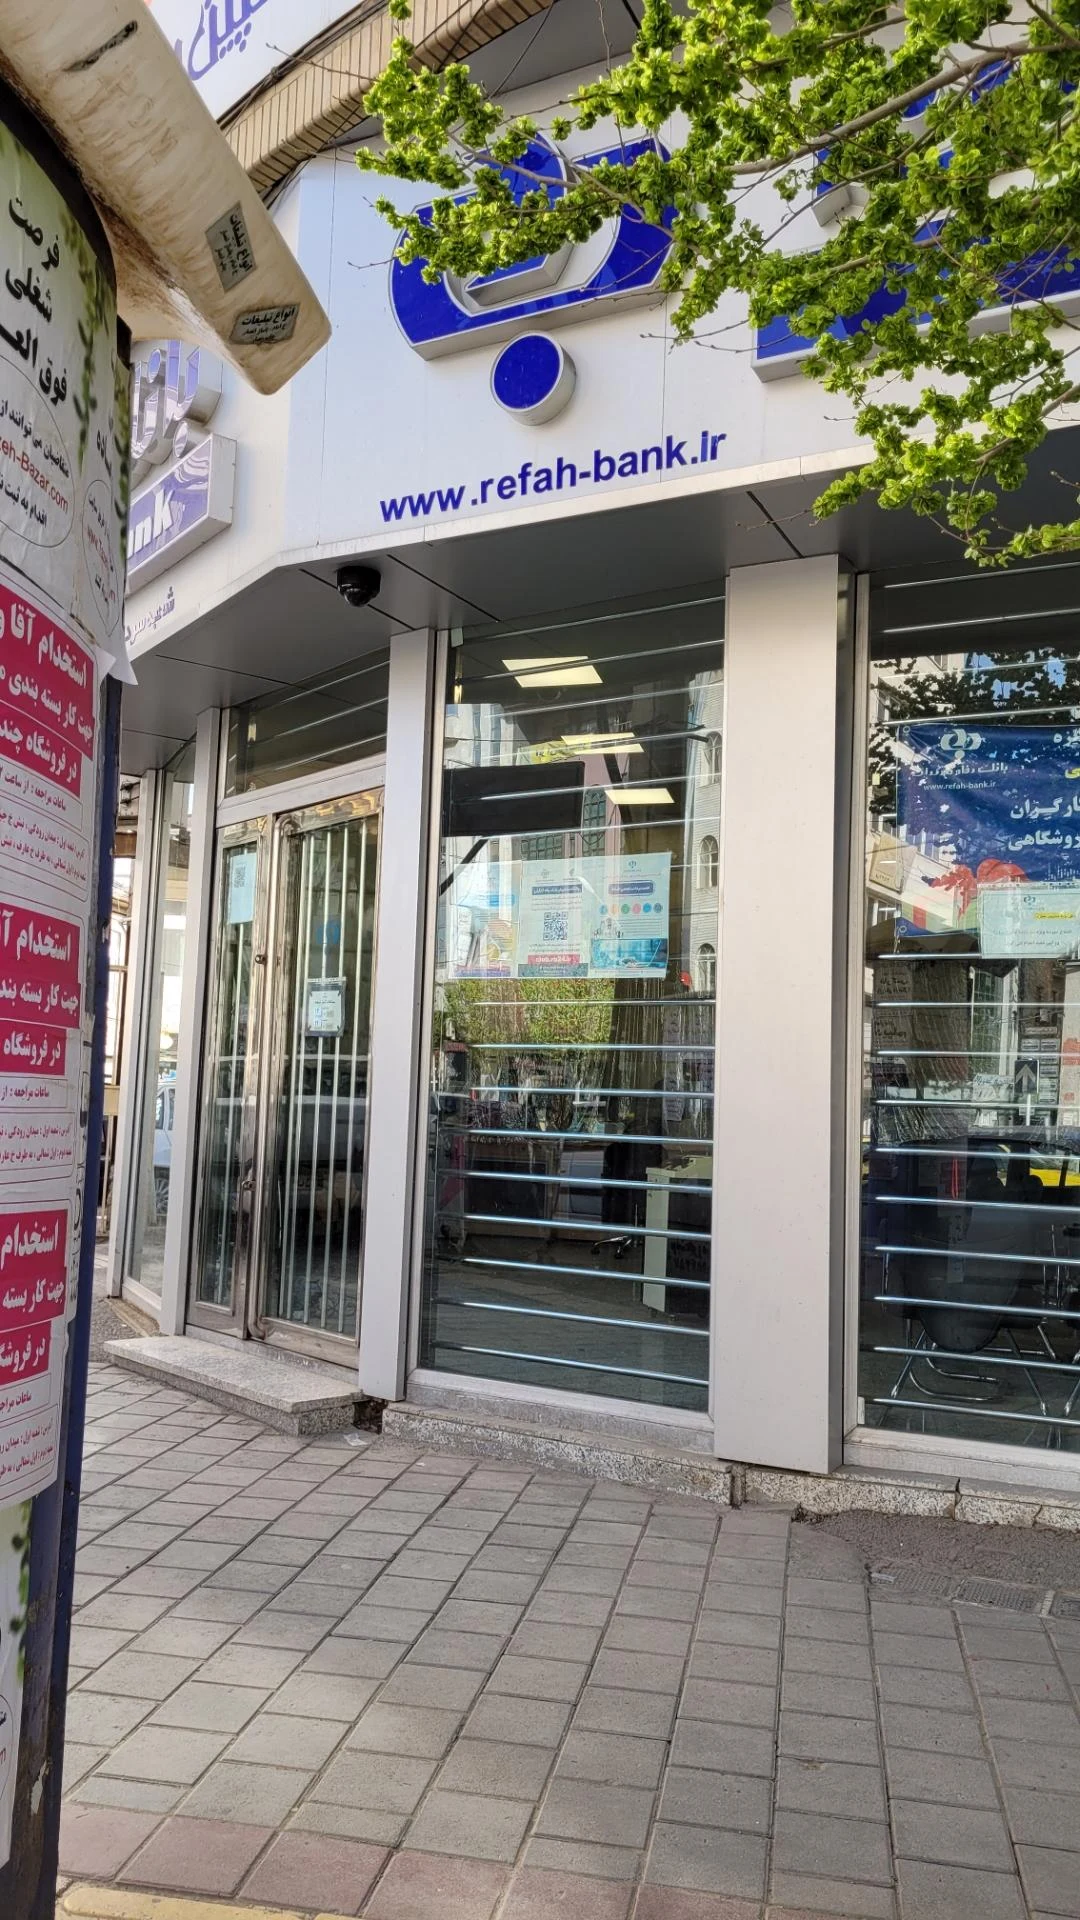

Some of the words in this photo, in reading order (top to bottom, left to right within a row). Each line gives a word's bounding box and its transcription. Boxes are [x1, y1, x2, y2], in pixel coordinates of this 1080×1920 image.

[9, 197, 60, 270] فرصت
[5, 266, 53, 323] شغلی
[0, 323, 38, 368] الع
[39, 357, 67, 406] فوق
[9, 409, 33, 439] توانند
[0, 436, 70, 515] eh-Bazar.com
[380, 430, 727, 523] www.refah-bank.ir
[10, 602, 36, 646] آقا
[37, 630, 88, 690] استخدام
[8, 667, 39, 707] بندی
[40, 686, 62, 723] بسته
[62, 701, 78, 729] کار
[26, 730, 67, 776] فروشگاه
[978, 762, 1009, 775] بانک
[66, 760, 78, 784] در
[923, 779, 997, 791] www.refah-bank.ir
[16, 919, 72, 962] استخدام
[0, 976, 17, 1007] بند
[20, 981, 43, 1011] بسته
[44, 983, 61, 1013] کار
[60, 988, 79, 1017] جهت
[3, 1031, 48, 1066] فروشگاه
[49, 1040, 61, 1067] در
[1, 1217, 59, 1271] استخدام
[2, 1287, 28, 1313] بسته
[28, 1277, 47, 1313] کار
[46, 1279, 65, 1304] جهت
[0, 1333, 32, 1373] فروشگ
[32, 1336, 46, 1367] در
